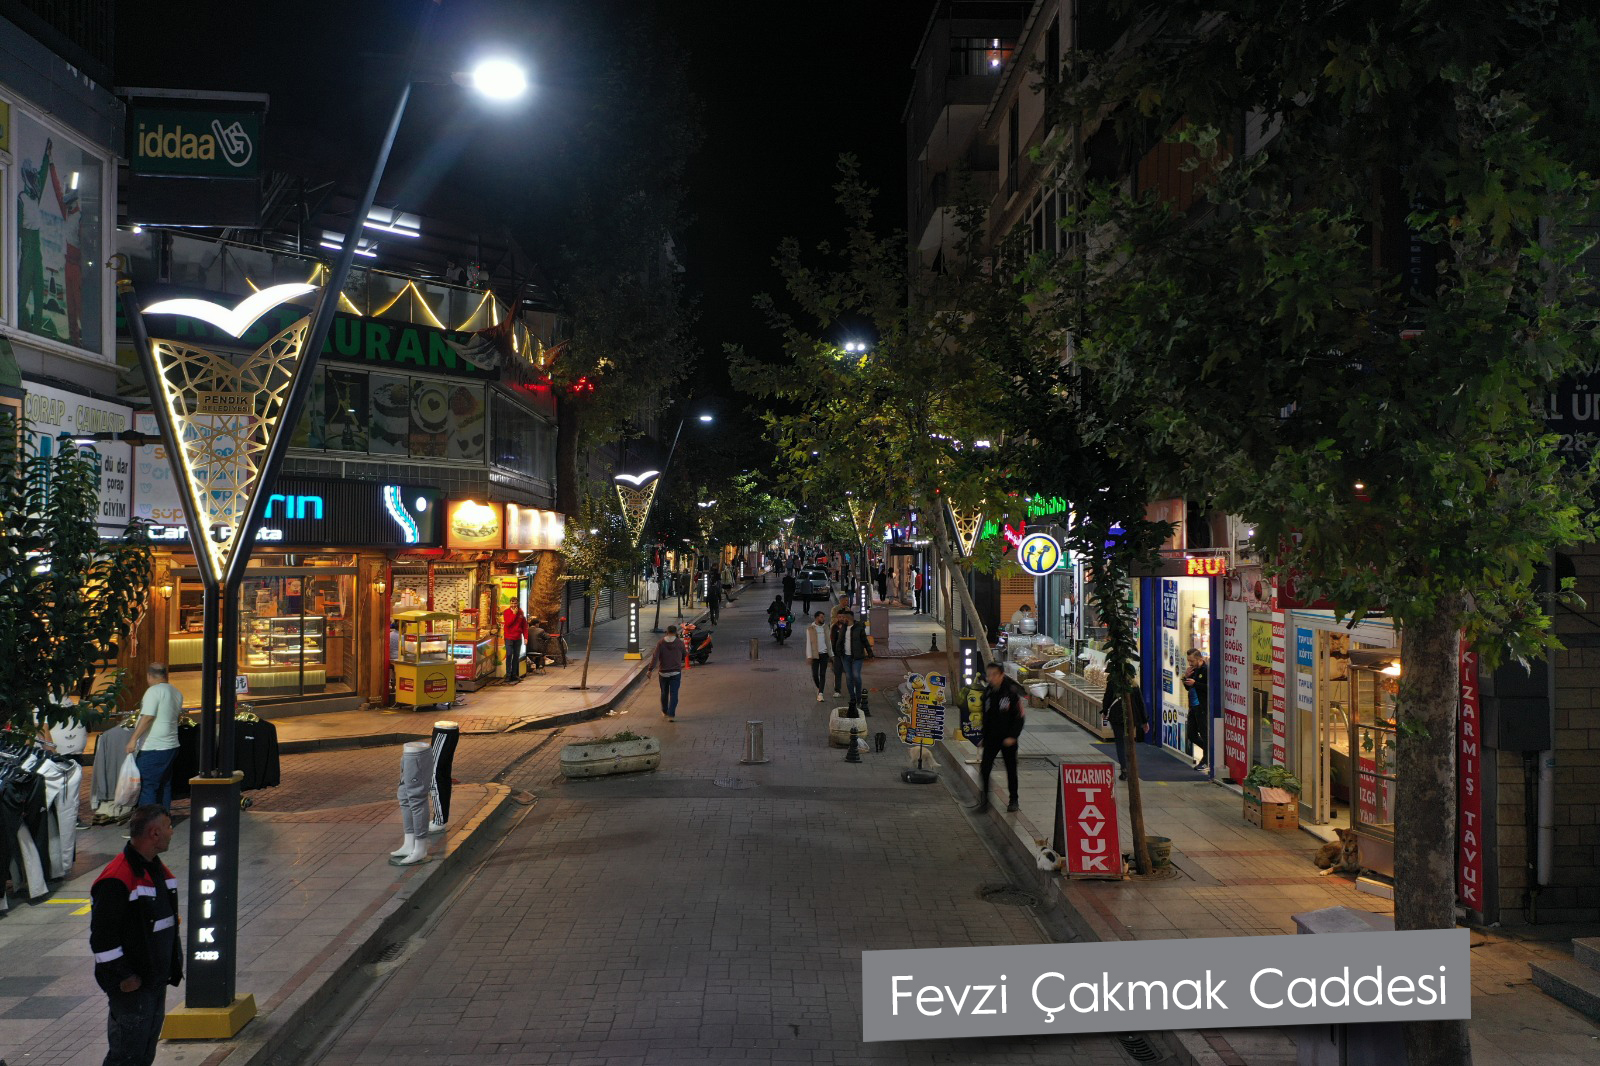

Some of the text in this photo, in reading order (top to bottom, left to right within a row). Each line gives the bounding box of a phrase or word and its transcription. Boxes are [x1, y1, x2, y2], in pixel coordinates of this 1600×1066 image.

[138, 123, 216, 160] iddaa
[204, 395, 248, 405] PENDİK
[103, 499, 126, 517] GİYİM
[1224, 626, 1236, 638] BUT
[1224, 652, 1246, 666] BONFİLE
[1224, 678, 1241, 690] KANAT
[1461, 651, 1477, 796] KIZARMIŞ
[1225, 744, 1246, 764] YAPILIR
[1065, 769, 1112, 788] KIZARMIŞ
[1077, 788, 1110, 871] TAVUK
[1463, 811, 1477, 902] TAVUK
[199, 806, 217, 943] PENDİK
